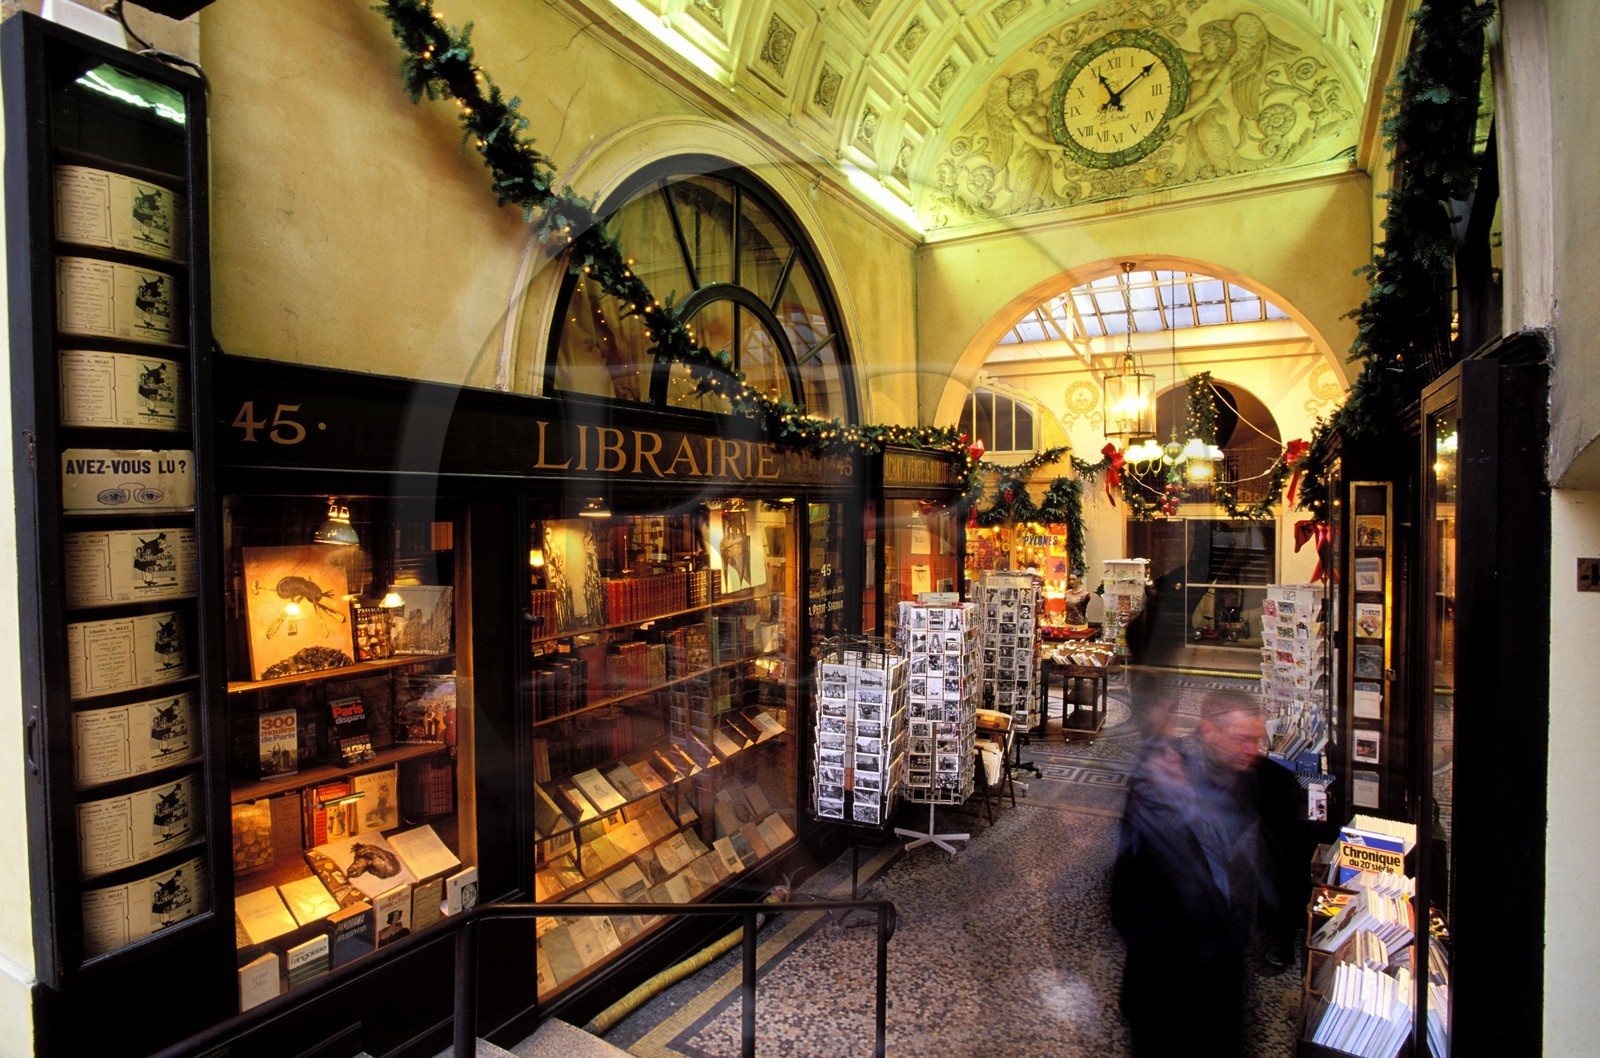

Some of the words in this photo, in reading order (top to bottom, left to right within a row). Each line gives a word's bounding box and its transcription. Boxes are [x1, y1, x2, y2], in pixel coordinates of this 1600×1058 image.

[1106, 57, 1121, 71] XII
[1130, 56, 1134, 68] I
[1076, 87, 1085, 99] X
[1151, 84, 1162, 97] III
[1070, 106, 1082, 118] IX
[1145, 110, 1156, 123] IV
[1077, 125, 1094, 138] VIII
[1097, 130, 1109, 143] VII
[1113, 132, 1123, 144] VI
[1130, 122, 1139, 133] V
[231, 400, 306, 446] 45
[531, 419, 782, 482] LIBRAIRIE
[65, 459, 152, 475] AVEZ-VOUS
[157, 459, 176, 474] LU
[178, 459, 187, 474] ?
[837, 455, 853, 477] 45
[1023, 535, 1058, 547] PYLONES
[820, 563, 832, 577] 45
[332, 703, 365, 719] Paris
[261, 715, 295, 731] 300
[335, 714, 366, 725] disparu
[261, 726, 296, 737] moulins
[273, 732, 296, 741] Paris
[1343, 845, 1401, 867] Chronique
[1349, 859, 1360, 867] du
[1376, 863, 1400, 875] siècle
